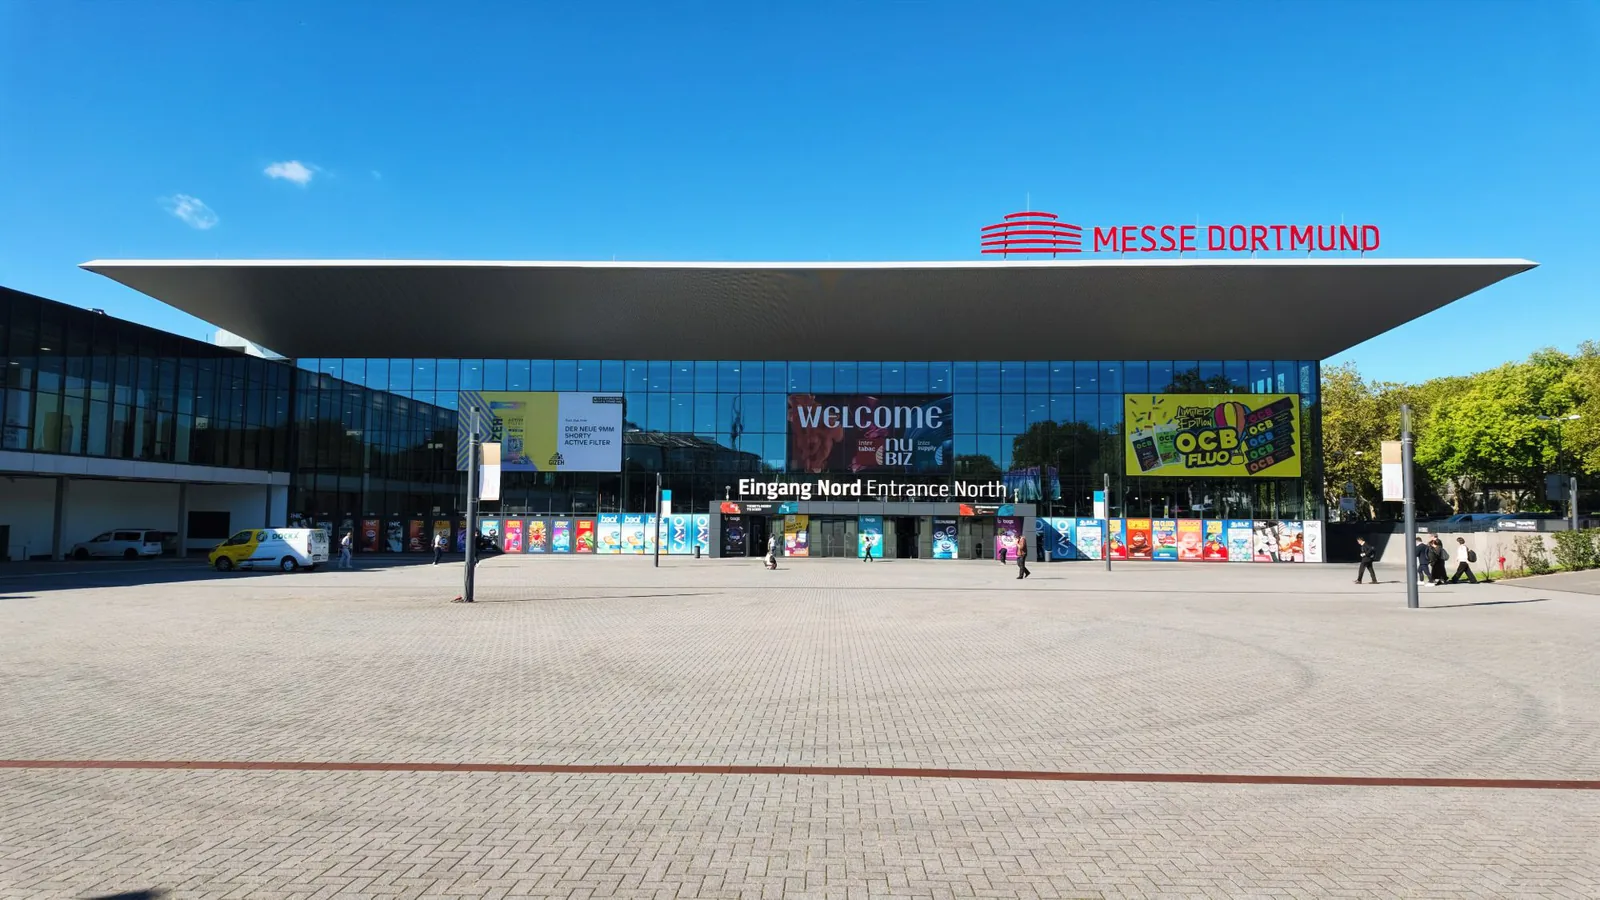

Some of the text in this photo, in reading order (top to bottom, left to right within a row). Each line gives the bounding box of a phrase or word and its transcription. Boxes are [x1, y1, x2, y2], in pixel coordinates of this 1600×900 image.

[1094, 225, 1381, 251] MESSE DORTMUND
[797, 405, 943, 429] WELCOME
[1177, 406, 1212, 418] LIMITED
[1248, 408, 1273, 423] OCB
[1179, 417, 1212, 430] EDITION
[1249, 419, 1274, 435] OCB
[885, 438, 913, 451] nu
[1176, 429, 1239, 453] OCB
[1249, 431, 1274, 446] OCB
[885, 452, 913, 465] BIZ
[1187, 450, 1230, 466] FLUO
[1250, 444, 1274, 459] OCB
[1250, 455, 1275, 472] OCB
[739, 478, 1006, 500] Eingang Nord Entrance North
[673, 516, 685, 552] CAMO
[1057, 520, 1070, 556] CAMO
